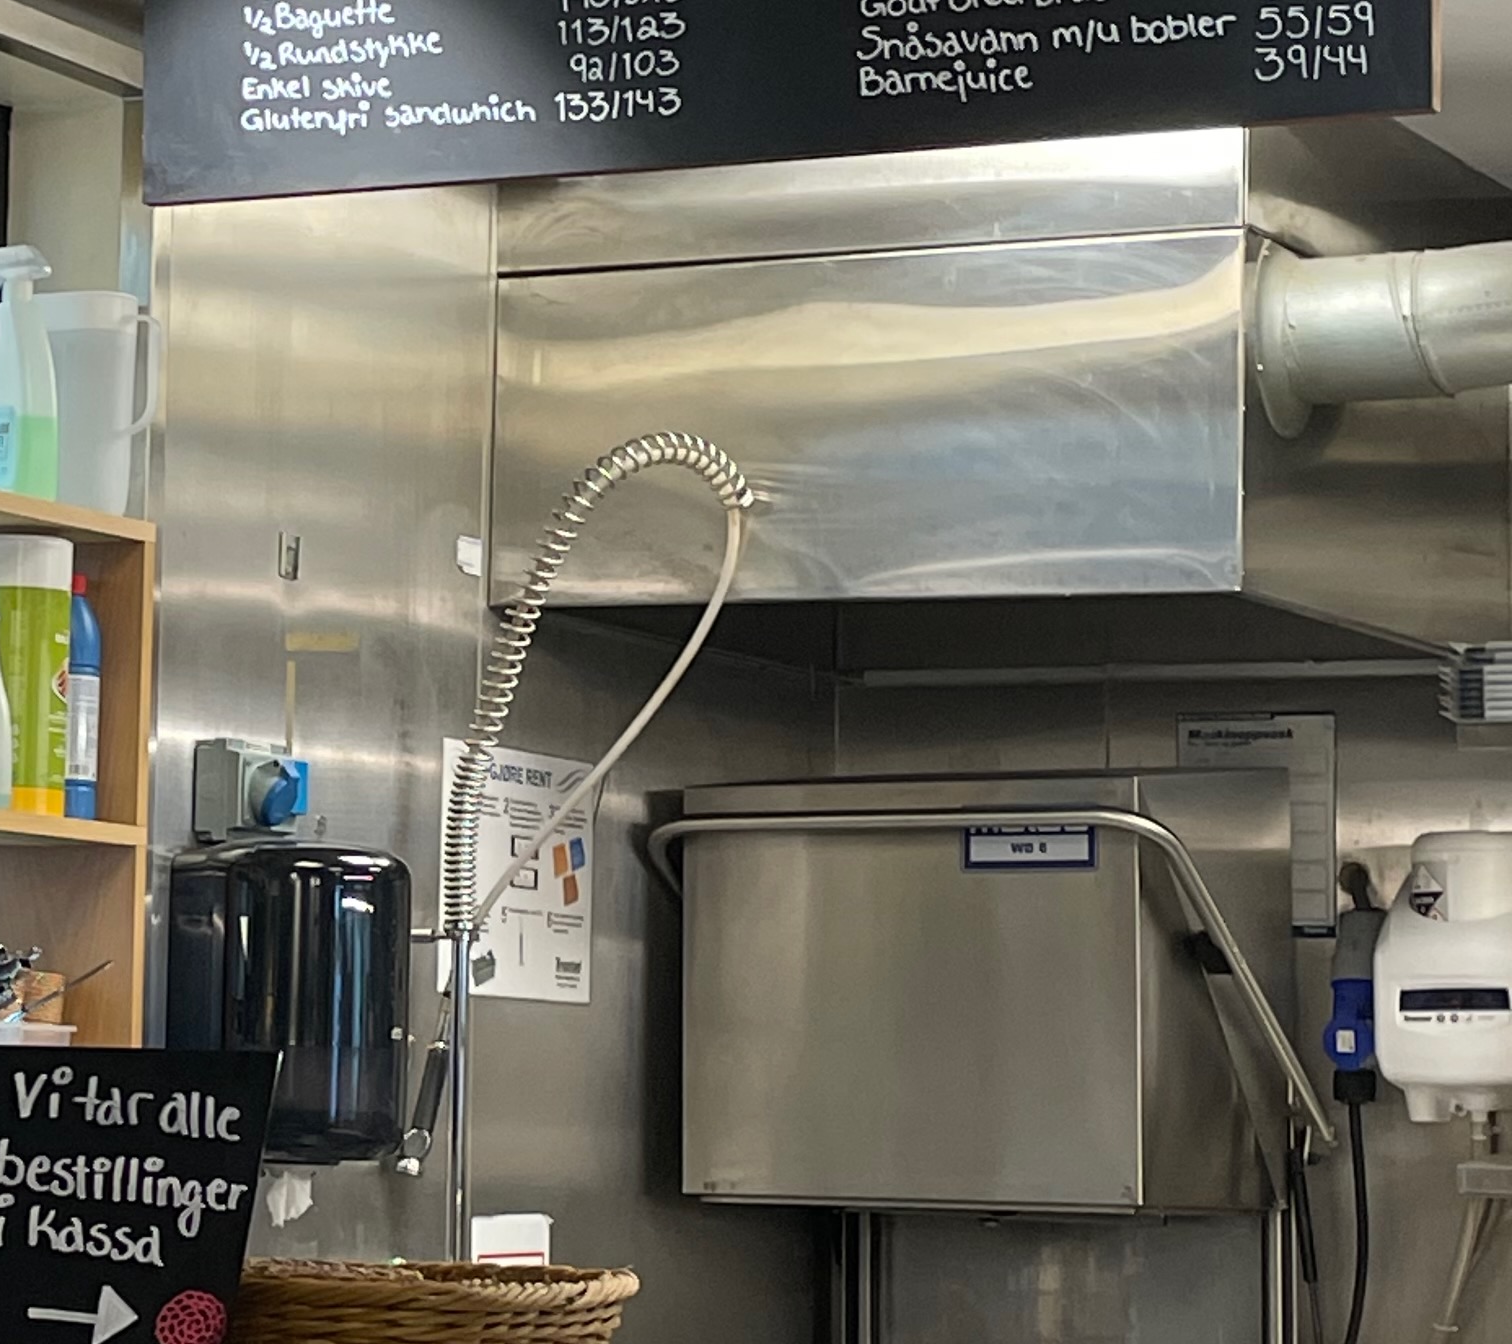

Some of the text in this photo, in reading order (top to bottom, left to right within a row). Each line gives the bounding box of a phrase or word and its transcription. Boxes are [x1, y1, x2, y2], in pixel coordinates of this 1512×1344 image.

[557, 11, 686, 46] 113/123
[856, 13, 1237, 61] Snåsavann m/u bobler
[1255, 0, 1374, 39] 55/59
[278, 30, 443, 68] Rundstykke
[569, 49, 680, 83] 92/103
[1254, 44, 1368, 81] 39/44
[242, 72, 392, 100] Enkel skive
[859, 58, 1034, 103] Barnejuice
[240, 93, 536, 136] Glutenfri sandwhich
[554, 87, 682, 122] 133/143
[14, 1066, 241, 1142] Vi tar alle
